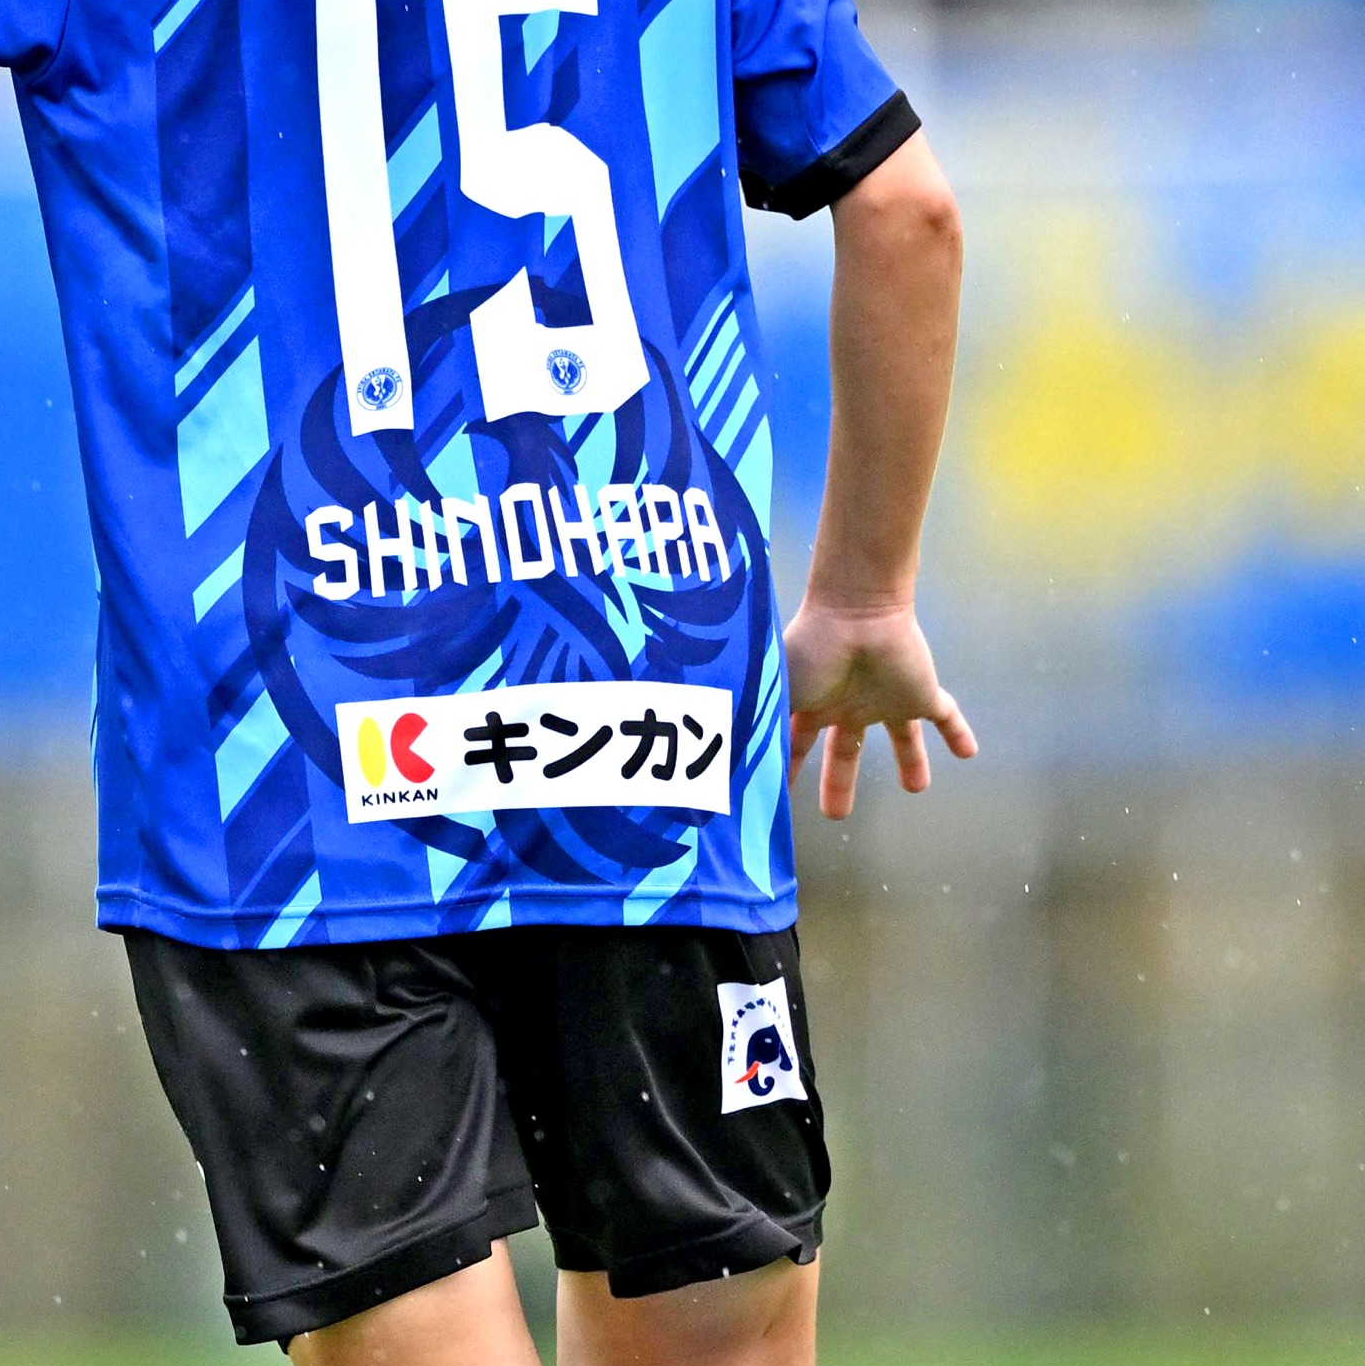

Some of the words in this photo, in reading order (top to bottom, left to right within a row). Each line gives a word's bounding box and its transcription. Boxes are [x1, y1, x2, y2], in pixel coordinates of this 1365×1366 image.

[305, 483, 732, 600] SHINOHARA
[464, 709, 723, 784] キンカン
[361, 788, 438, 807] KINKAN
